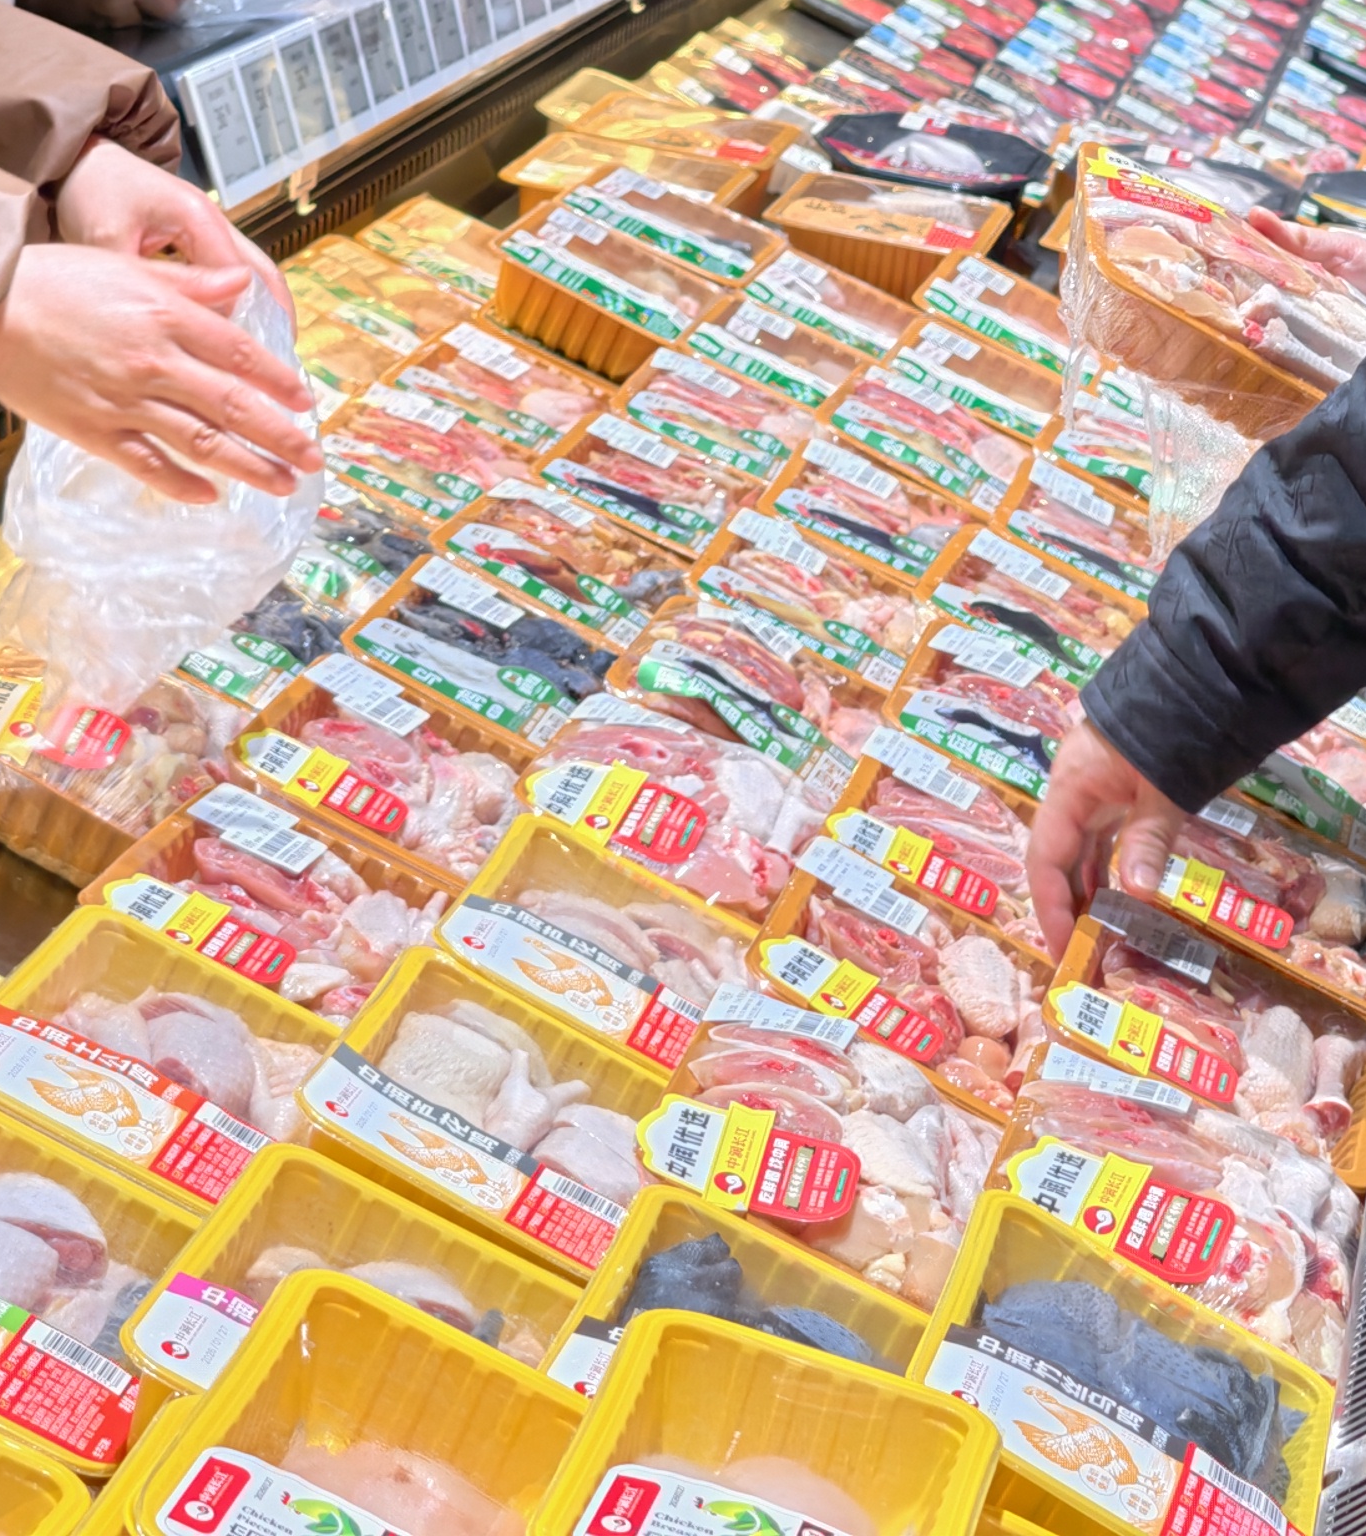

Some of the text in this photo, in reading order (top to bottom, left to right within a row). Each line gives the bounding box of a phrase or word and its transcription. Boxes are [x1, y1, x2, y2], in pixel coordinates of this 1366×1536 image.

[11, 1015, 162, 1091] 中润土公鸡
[663, 1107, 713, 1181] 中润优选
[724, 1125, 751, 1170] 中润长江
[173, 1305, 205, 1347] 中润长江
[240, 1504, 294, 1536] Chicken
[653, 1510, 716, 1536] Chicken
